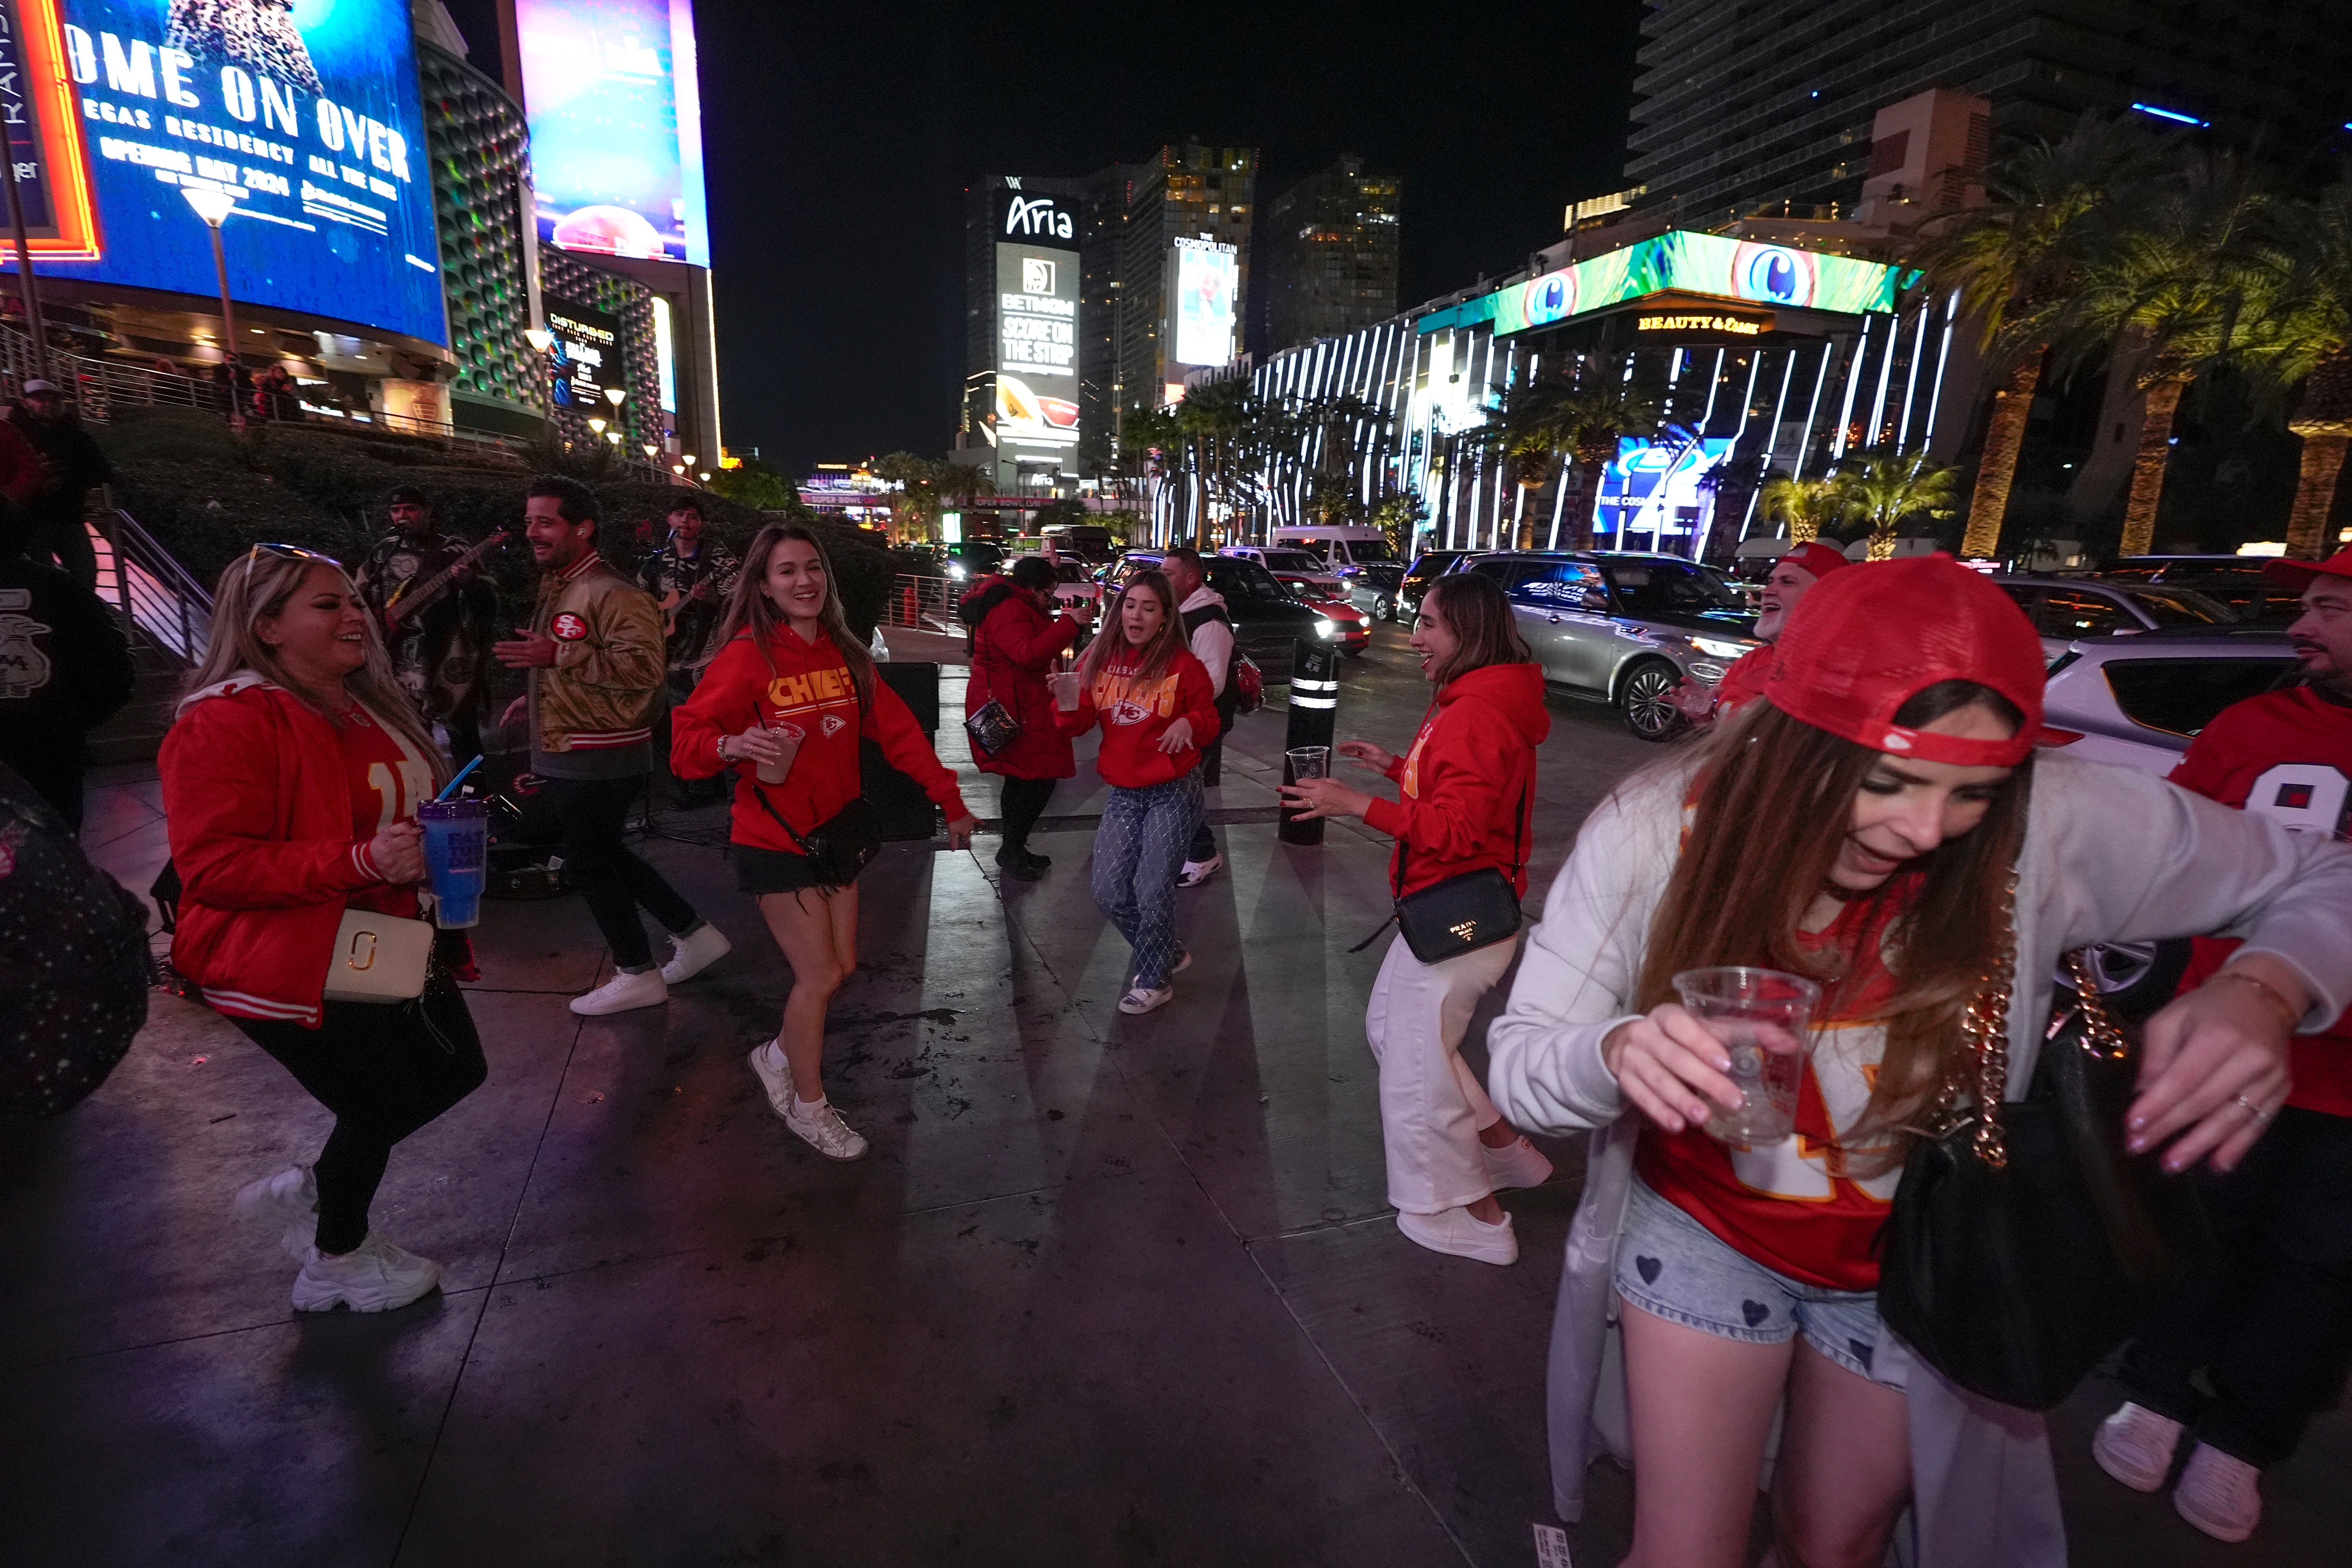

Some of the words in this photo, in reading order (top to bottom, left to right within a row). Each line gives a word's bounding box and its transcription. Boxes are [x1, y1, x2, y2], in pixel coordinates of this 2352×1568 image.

[82, 98, 151, 130] EGAS
[165, 115, 294, 165] RESIDENCY
[221, 65, 299, 137] ON
[316, 98, 411, 183] OVER
[242, 167, 290, 196] 2024
[1006, 196, 1073, 238] Aria
[1174, 236, 1238, 255] COSMOPOLITAN
[1200, 232, 1214, 241] THE
[1002, 293, 1074, 316] BETMGM
[550, 313, 614, 342] DISTURBED
[1002, 316, 1053, 341] SCORE
[1052, 321, 1073, 344] ON
[1638, 316, 1713, 330] BEAUTY
[1002, 339, 1033, 361] THE
[1033, 341, 1074, 365] STRIP
[1601, 496, 1621, 506] THE
[768, 666, 856, 706] CHIEF
[1450, 920, 1477, 933] PRADA
